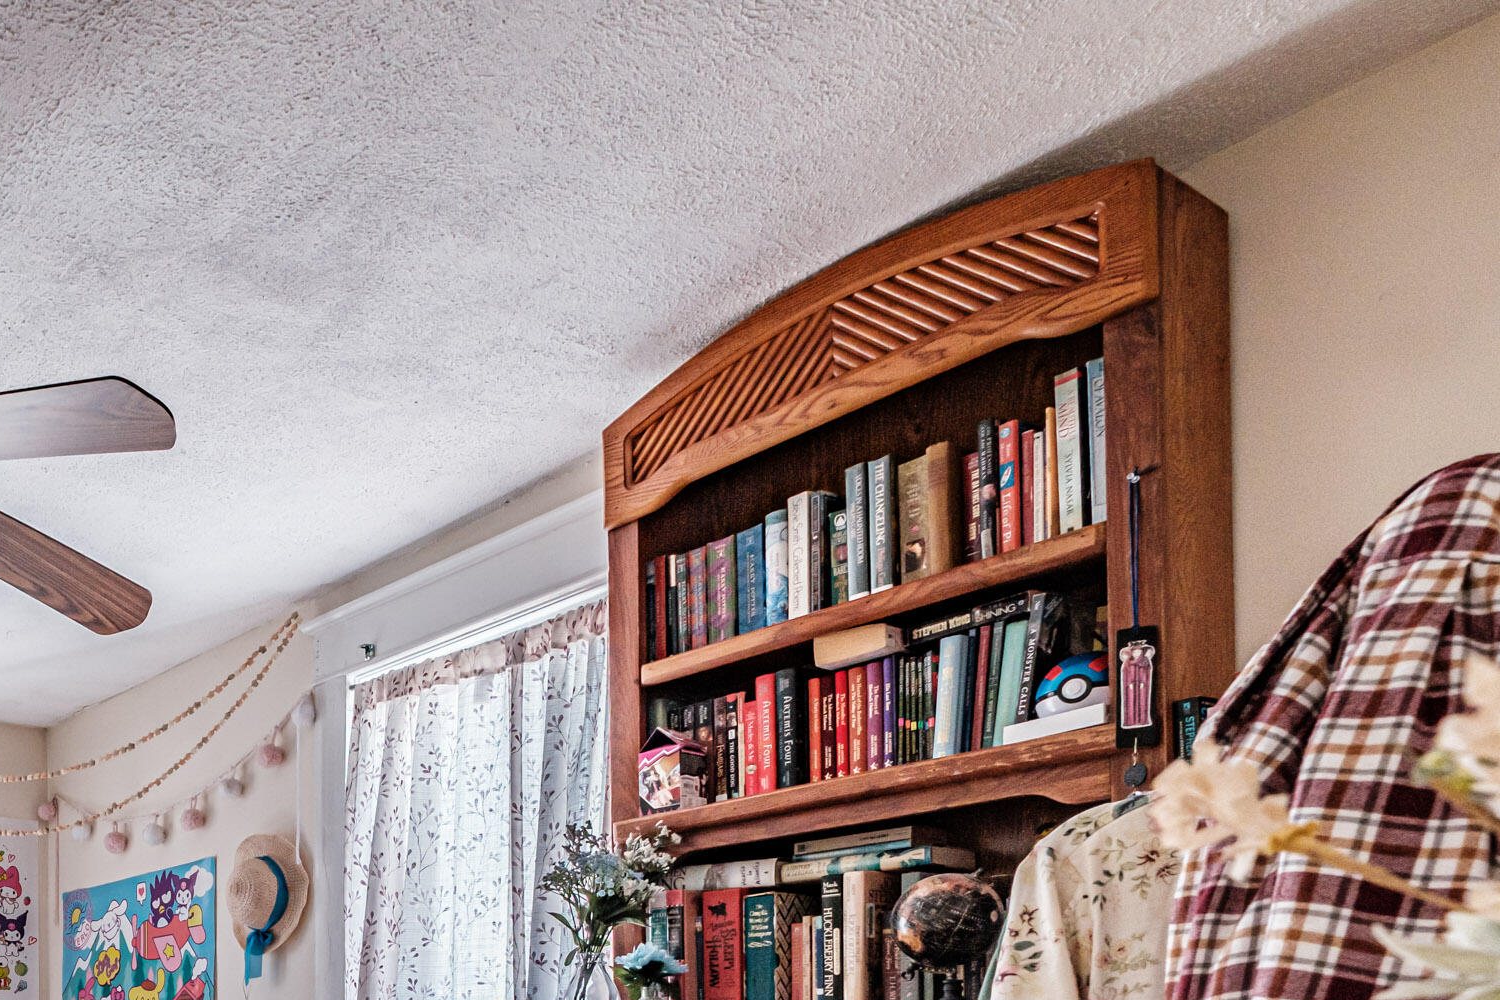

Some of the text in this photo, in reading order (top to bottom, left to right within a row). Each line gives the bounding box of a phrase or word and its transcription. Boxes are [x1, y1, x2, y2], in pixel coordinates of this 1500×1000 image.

[1058, 402, 1068, 439] MIND
[1094, 396, 1105, 437] AVALON
[875, 462, 886, 546] THE CHANGELING
[1064, 450, 1074, 515] SYLVIA NASAR
[793, 522, 803, 545] Smith
[1002, 492, 1012, 544] Life of Pi
[792, 547, 804, 585] Collected
[912, 614, 971, 640] STEPHEN KING
[975, 603, 1016, 622] SHINING
[1022, 638, 1036, 684] MONSTER
[1018, 687, 1028, 716] CALLS
[762, 701, 772, 770] ARTEMIS FOWL
[783, 695, 793, 766] ARTEMIS FOWL
[705, 940, 720, 989] HOLLOW
[721, 928, 737, 971] SLEEPY
[824, 908, 834, 996] HUCKLEBERRY FINN
